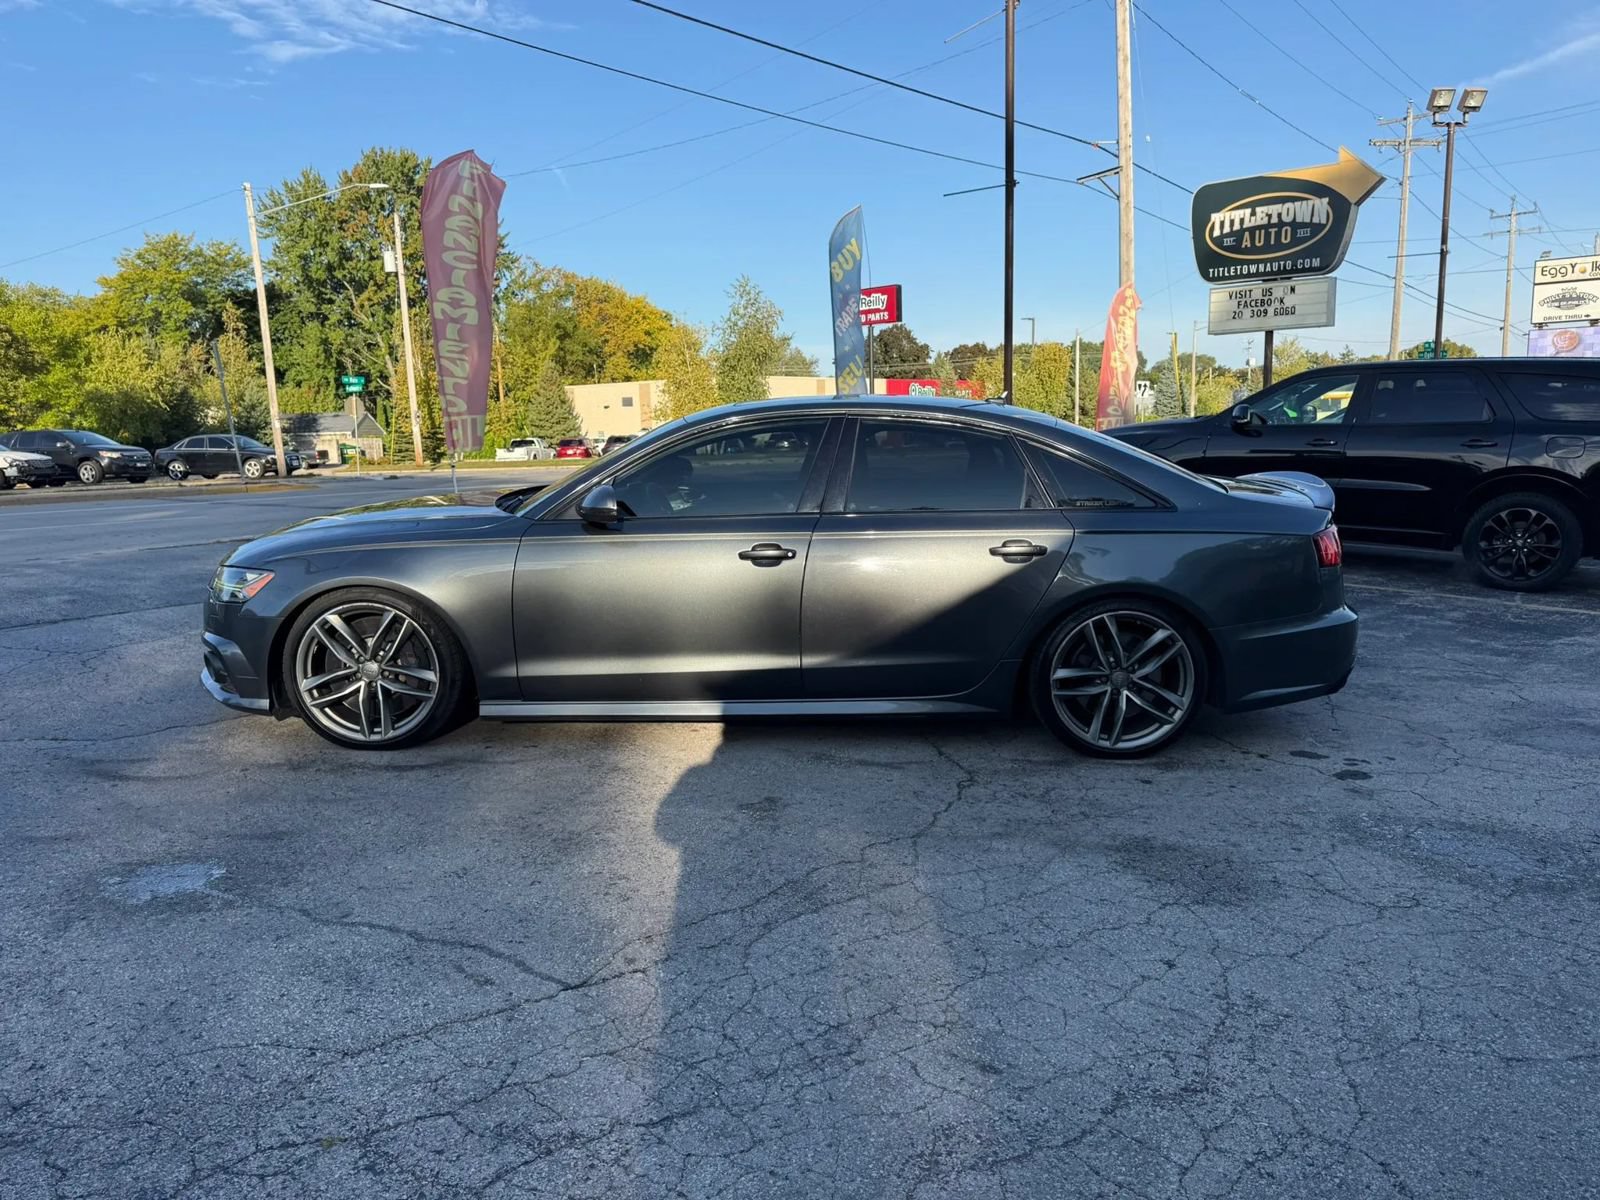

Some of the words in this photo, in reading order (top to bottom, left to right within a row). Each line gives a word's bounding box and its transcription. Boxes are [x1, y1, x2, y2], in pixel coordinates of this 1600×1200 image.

[1210, 197, 1330, 238] TITLETOWN
[1241, 226, 1292, 249] AUTO
[831, 237, 862, 283] BUY
[1208, 258, 1321, 277] TITLETOWNAUTO.COM
[861, 294, 887, 309] Reilly
[1228, 290, 1253, 300] VISIT
[1262, 288, 1273, 297] US
[1232, 311, 1244, 320] 20
[1250, 308, 1268, 318] 309
[1273, 306, 1296, 316] 6060
